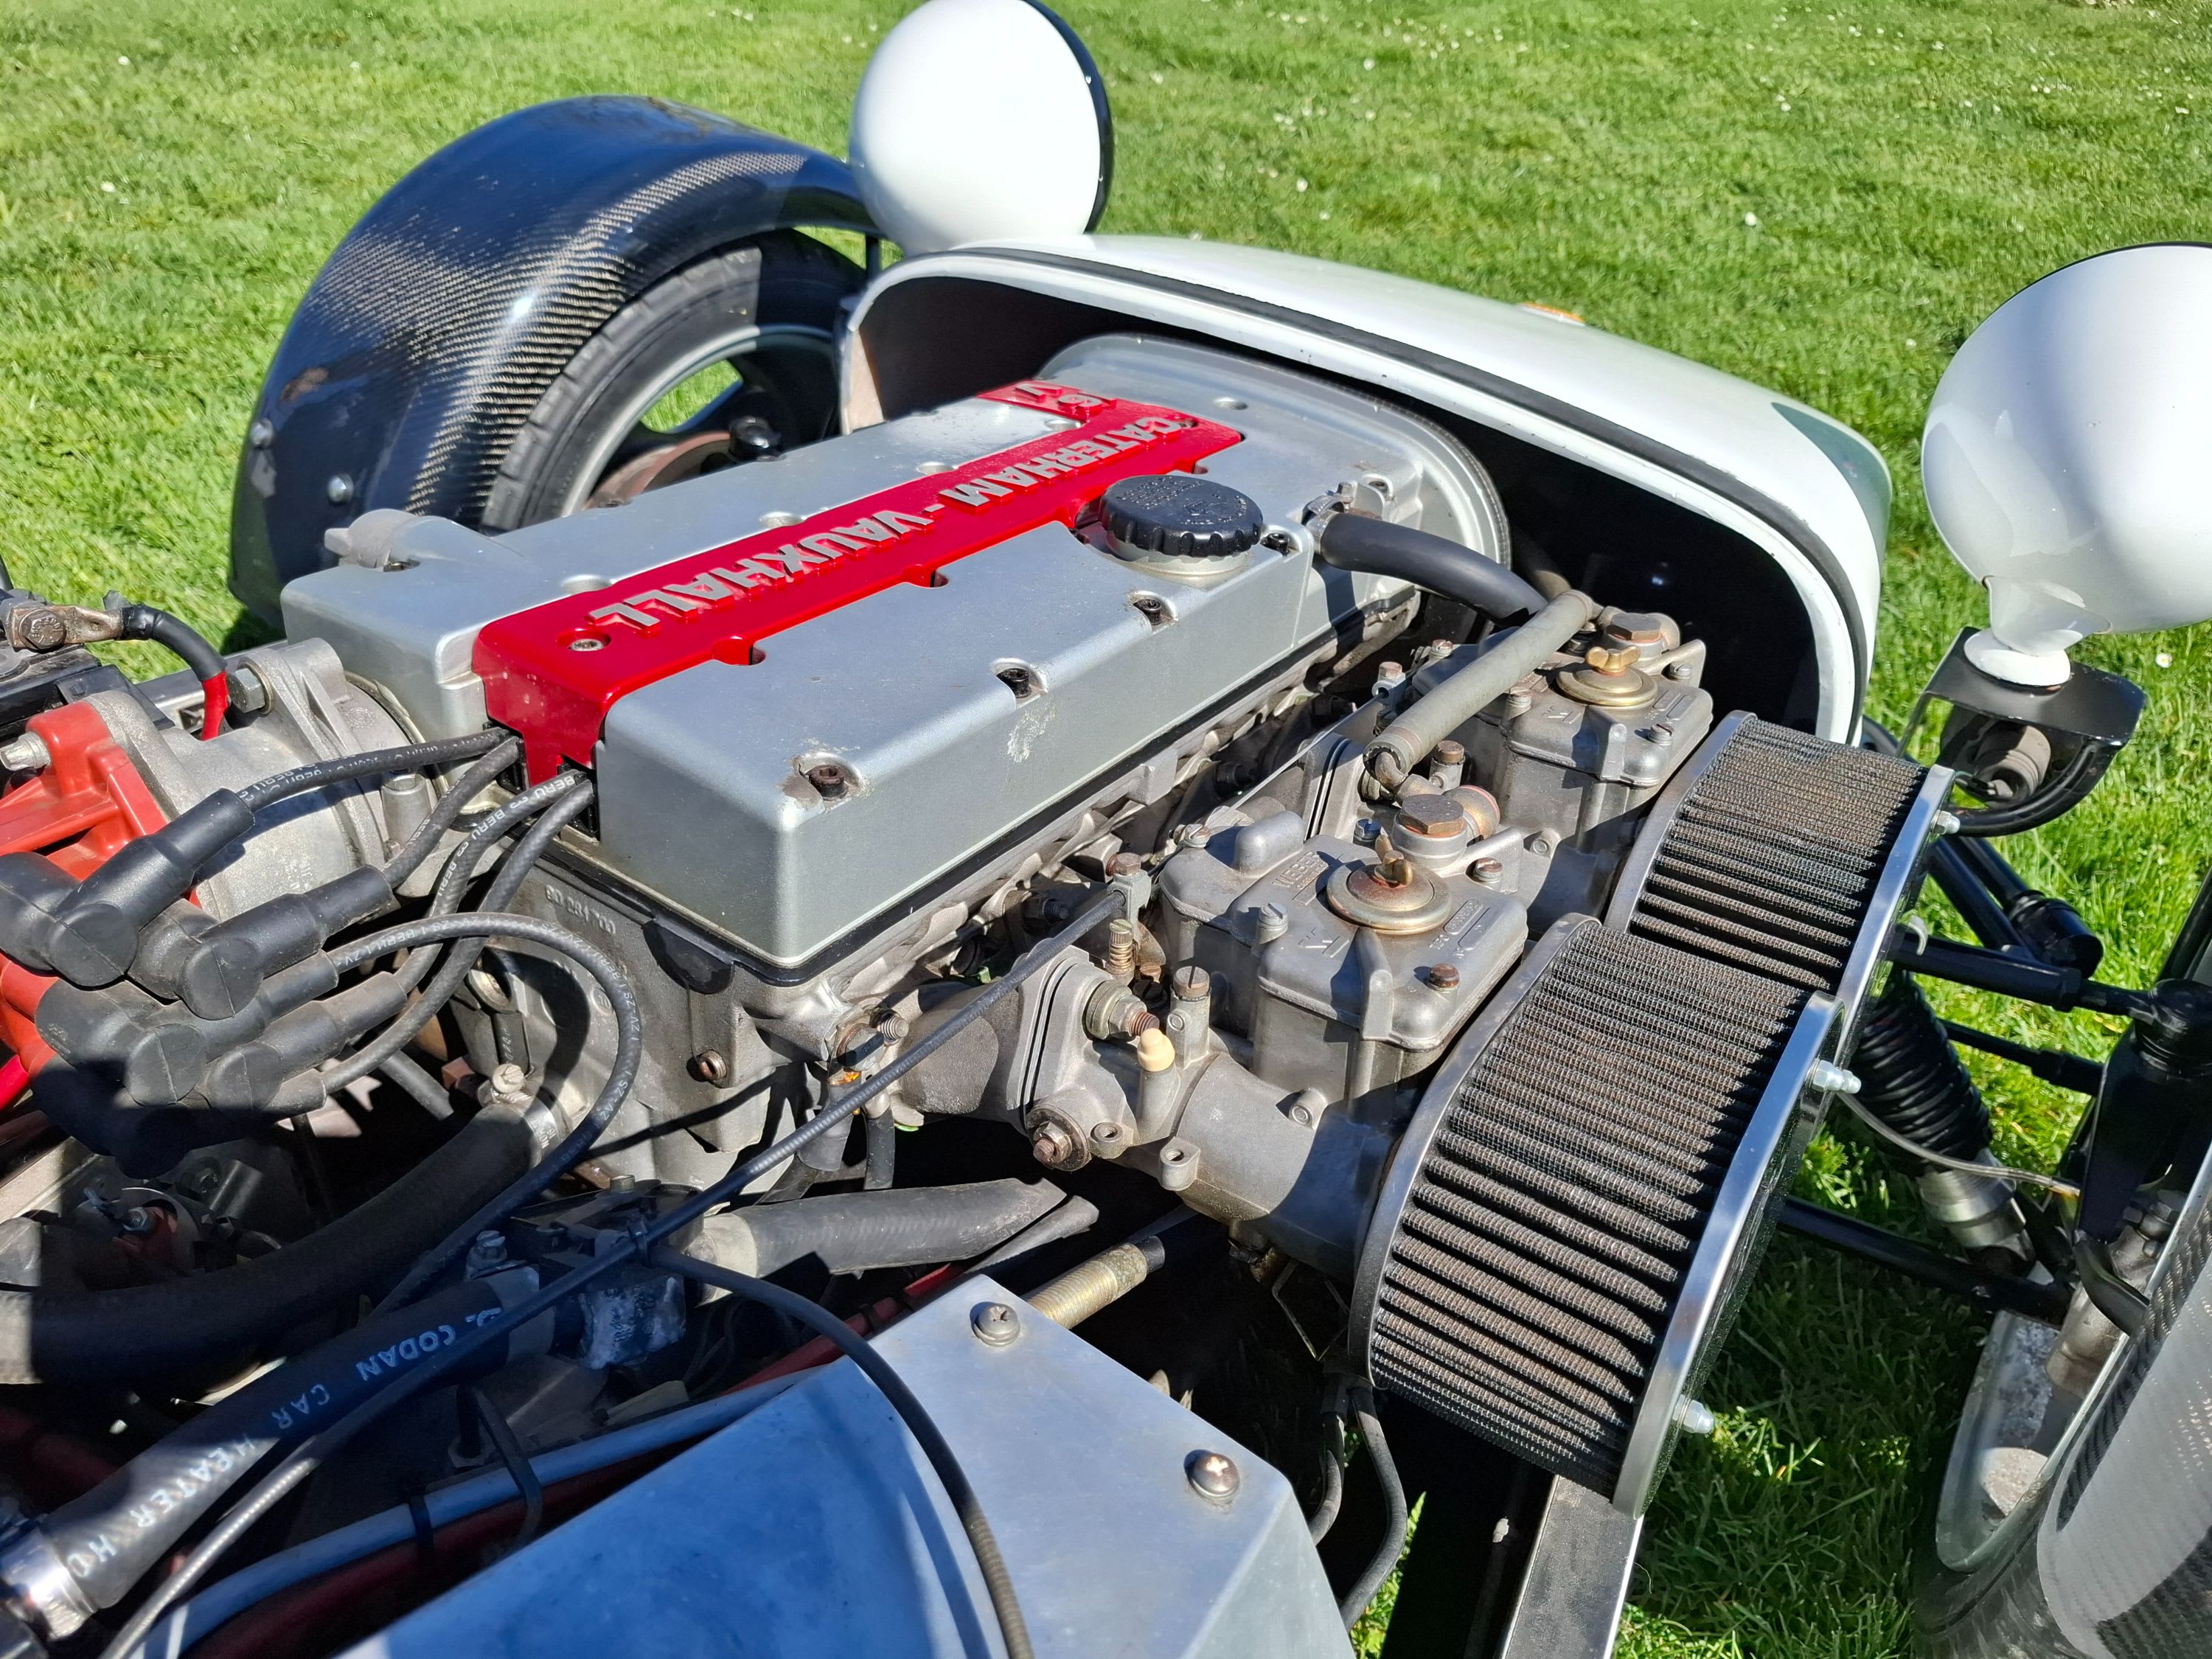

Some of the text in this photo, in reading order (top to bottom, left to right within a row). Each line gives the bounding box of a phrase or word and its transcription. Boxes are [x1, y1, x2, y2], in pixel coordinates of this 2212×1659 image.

[939, 413, 1179, 507] CATERHAM
[592, 509, 928, 630] VAUXHALL
[534, 775, 575, 798] BERU
[471, 809, 505, 840] BERU
[438, 861, 457, 897] BERU
[1272, 852, 1320, 888] WEBER
[355, 1324, 456, 1381] CODAN
[271, 1383, 331, 1430] CAR
[129, 1434, 256, 1528] HEATER
